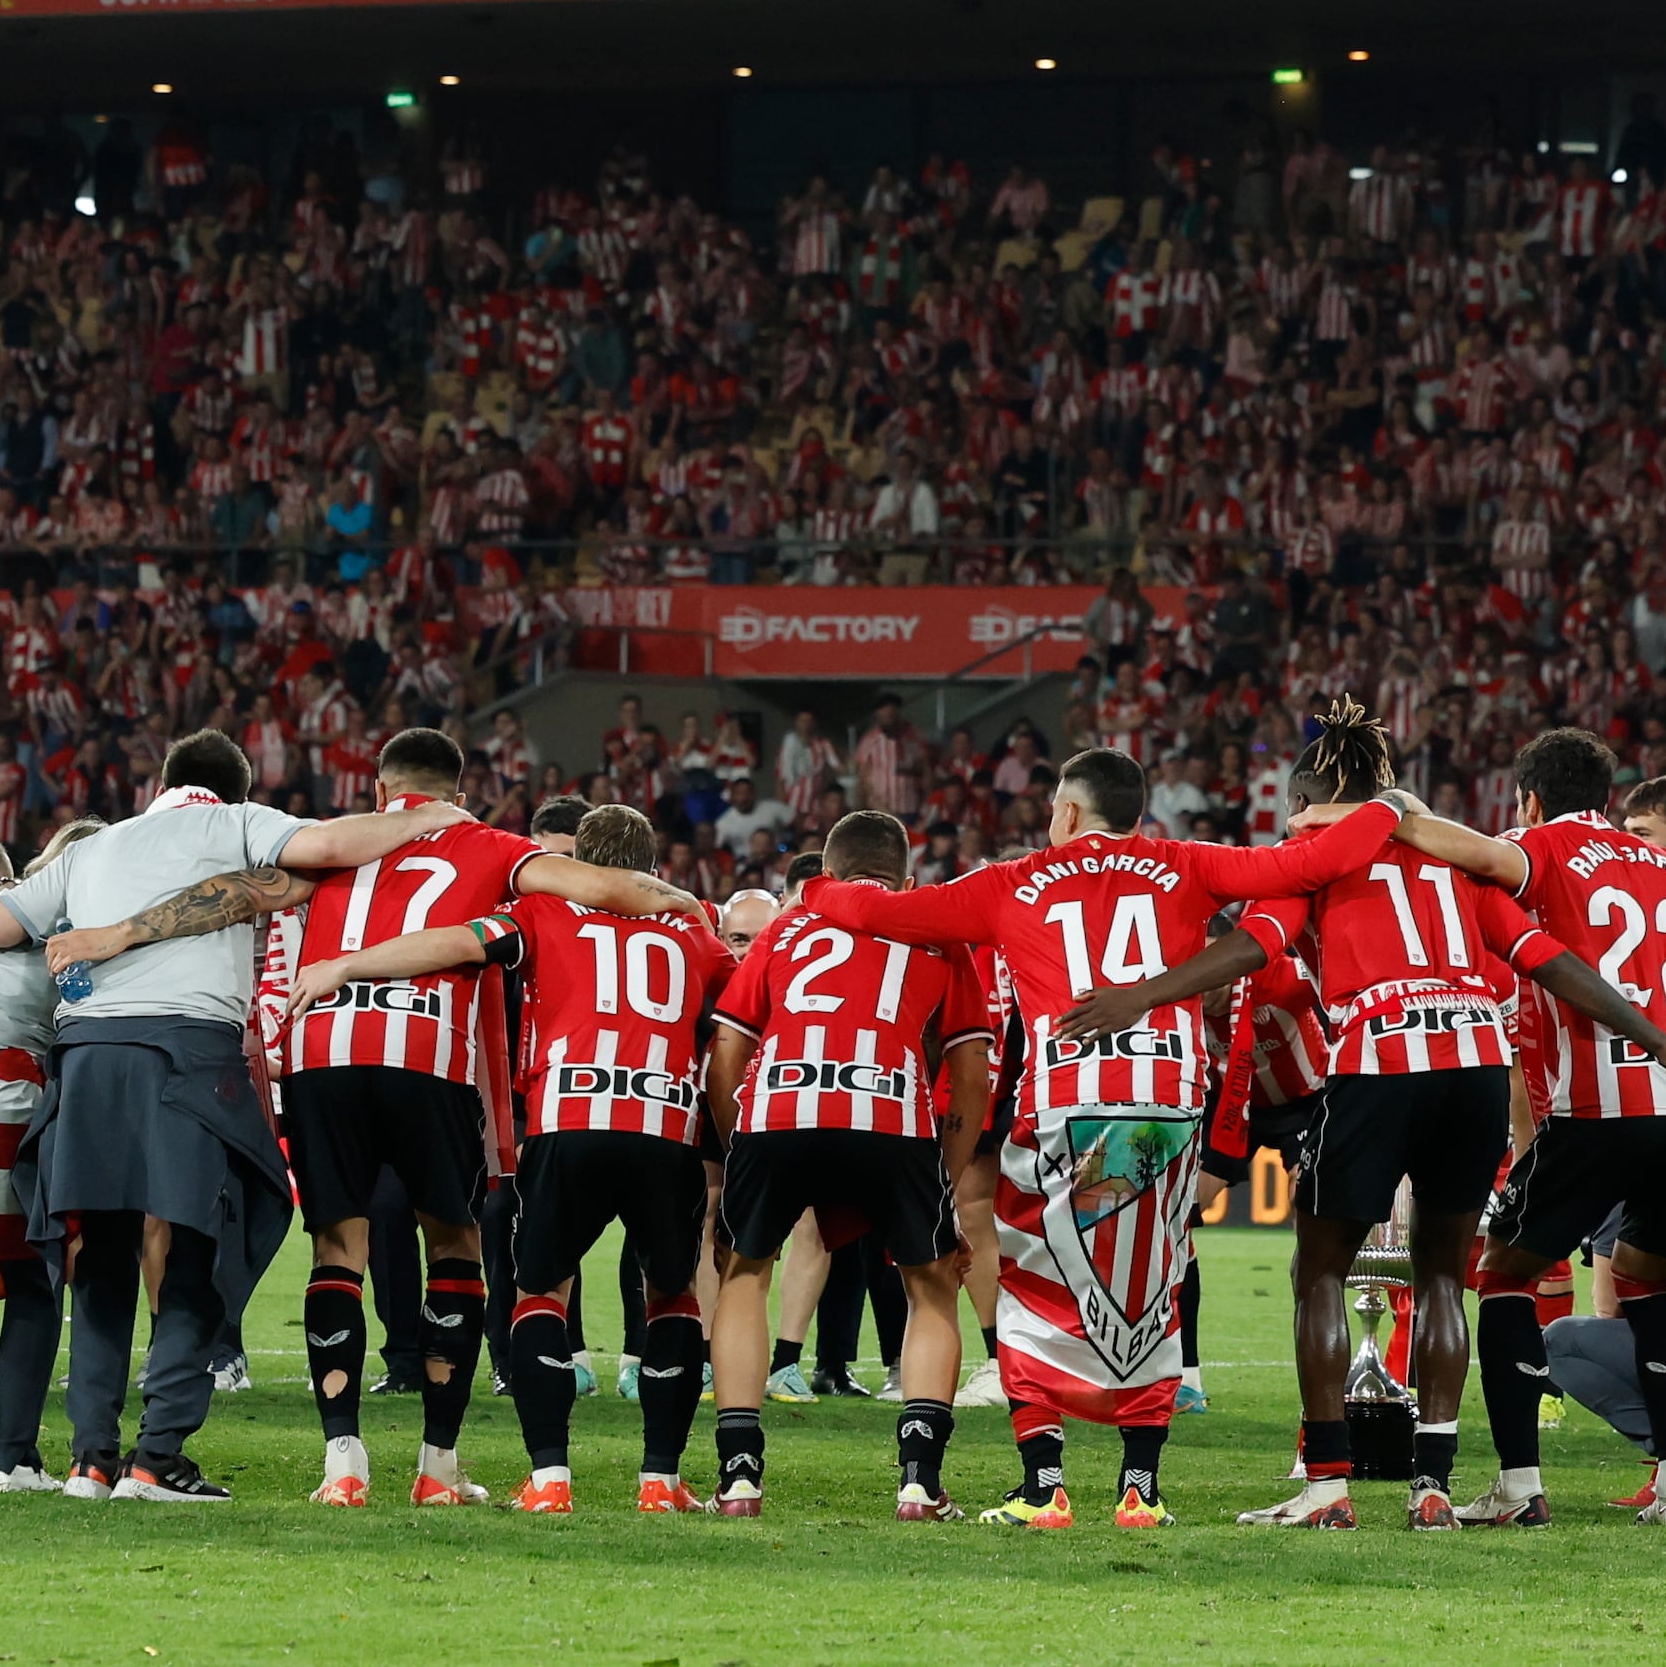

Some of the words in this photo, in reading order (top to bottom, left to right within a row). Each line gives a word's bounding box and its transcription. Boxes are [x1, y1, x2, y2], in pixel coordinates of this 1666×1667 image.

[764, 614, 920, 643] FACTORY
[339, 854, 459, 952] 17
[1014, 858, 1077, 907] DANI
[1081, 853, 1183, 895] GARCÍA
[1367, 862, 1470, 969] 11
[1042, 892, 1170, 998] 14
[575, 921, 688, 1025] 10
[782, 926, 912, 1025] 21
[302, 980, 443, 1021] DIGI
[1043, 1020, 1186, 1070] DIGI
[557, 1063, 702, 1112] DIGI
[765, 1059, 909, 1102] DIGI
[1230, 1049, 1253, 1098] SEVILLA
